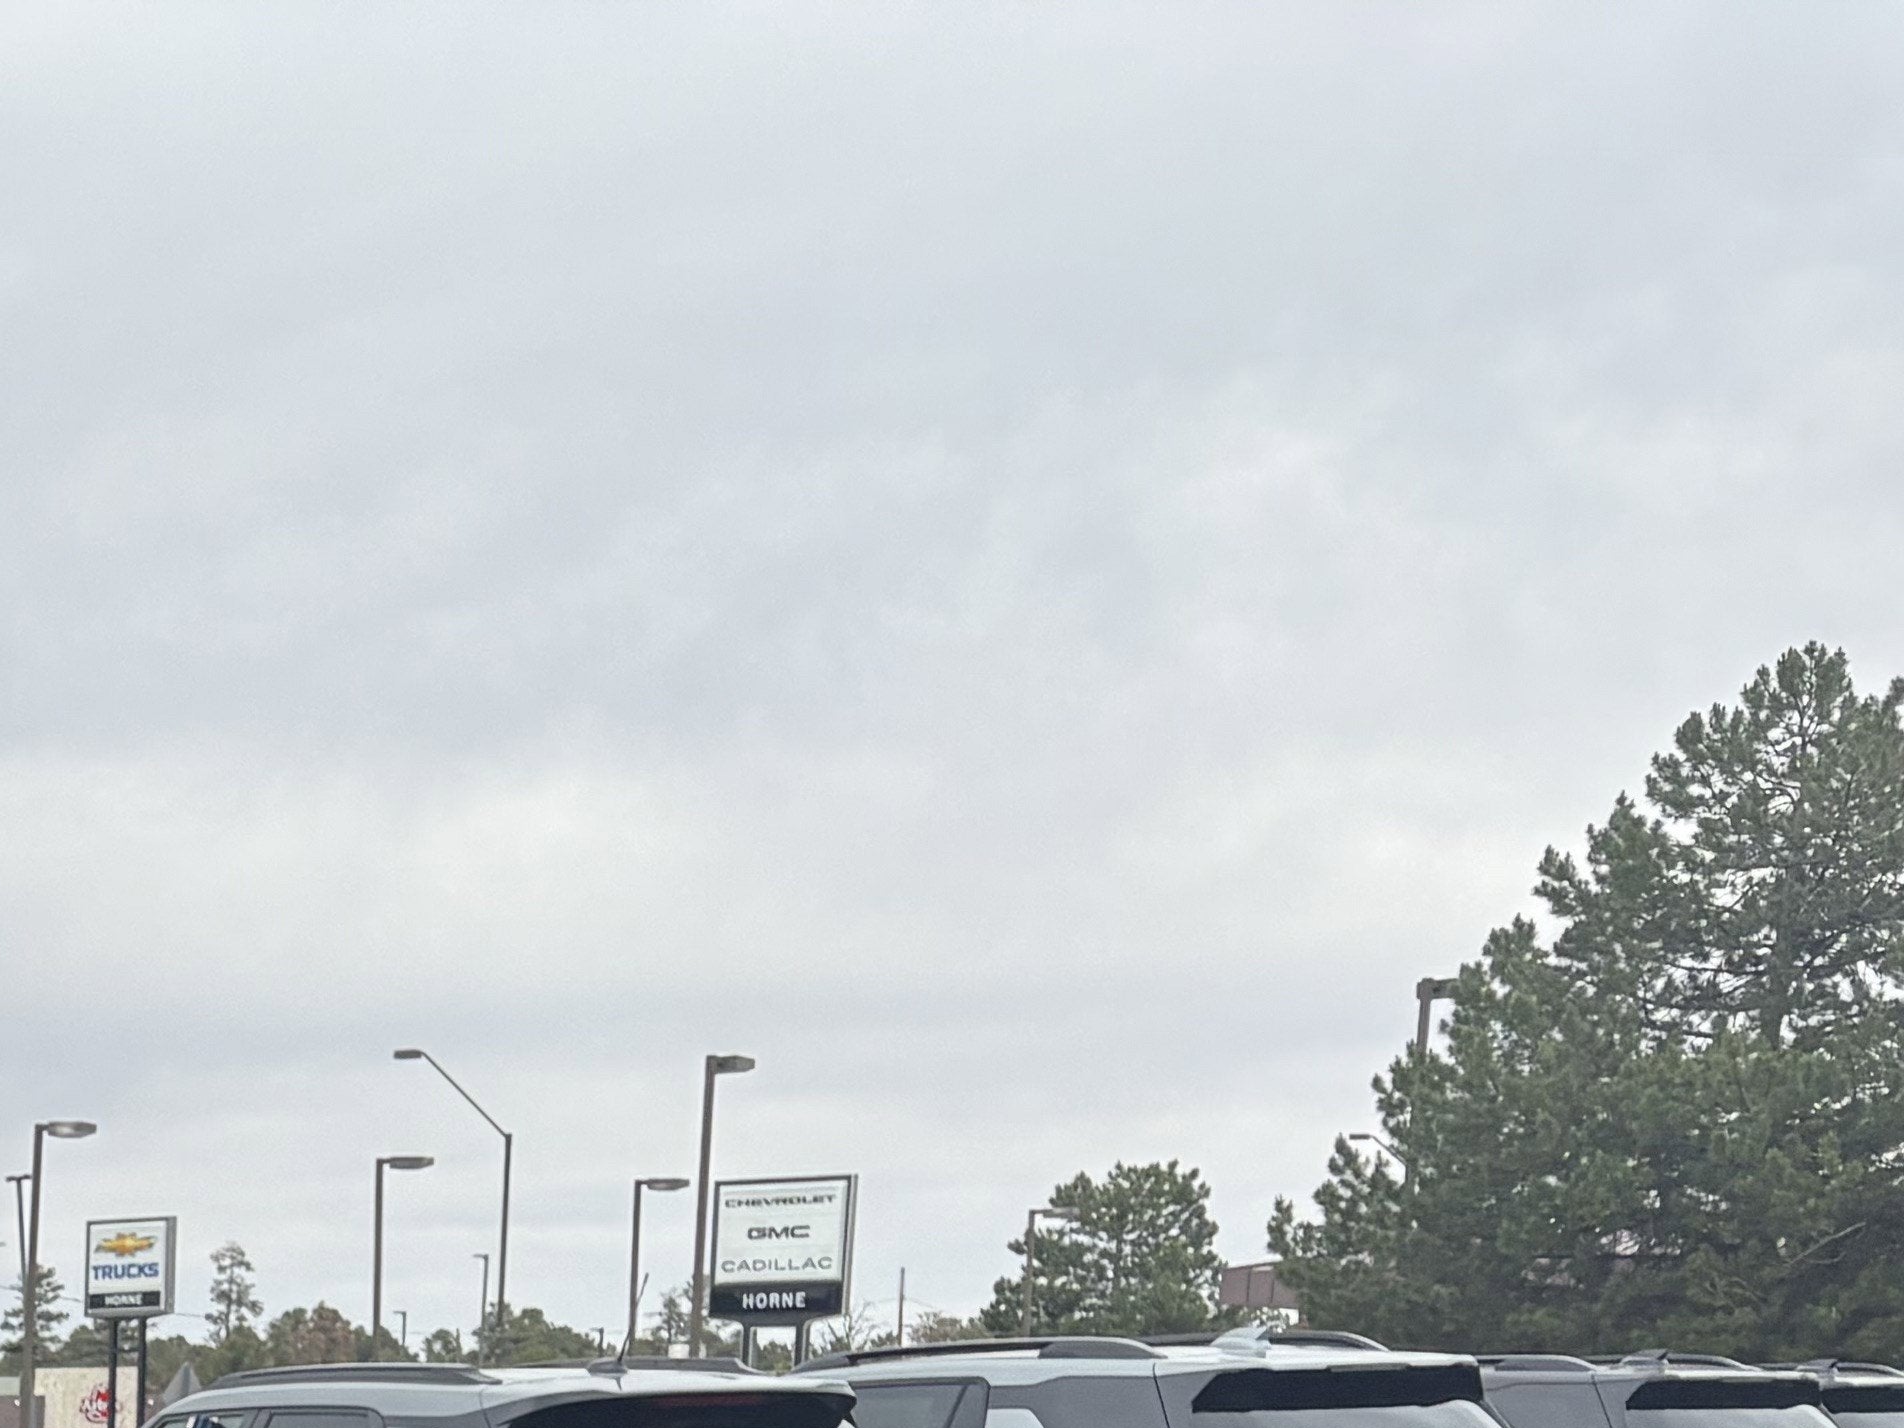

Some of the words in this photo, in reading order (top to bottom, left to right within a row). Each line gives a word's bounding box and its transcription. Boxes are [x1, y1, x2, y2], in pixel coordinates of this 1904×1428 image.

[725, 1194, 836, 1208] CHEVROLET
[747, 1225, 810, 1240] GMC
[92, 1262, 159, 1280] TRUCKS
[721, 1256, 832, 1273] CADILLAC
[104, 1293, 142, 1305] HORNE
[742, 1291, 807, 1310] HORNE
